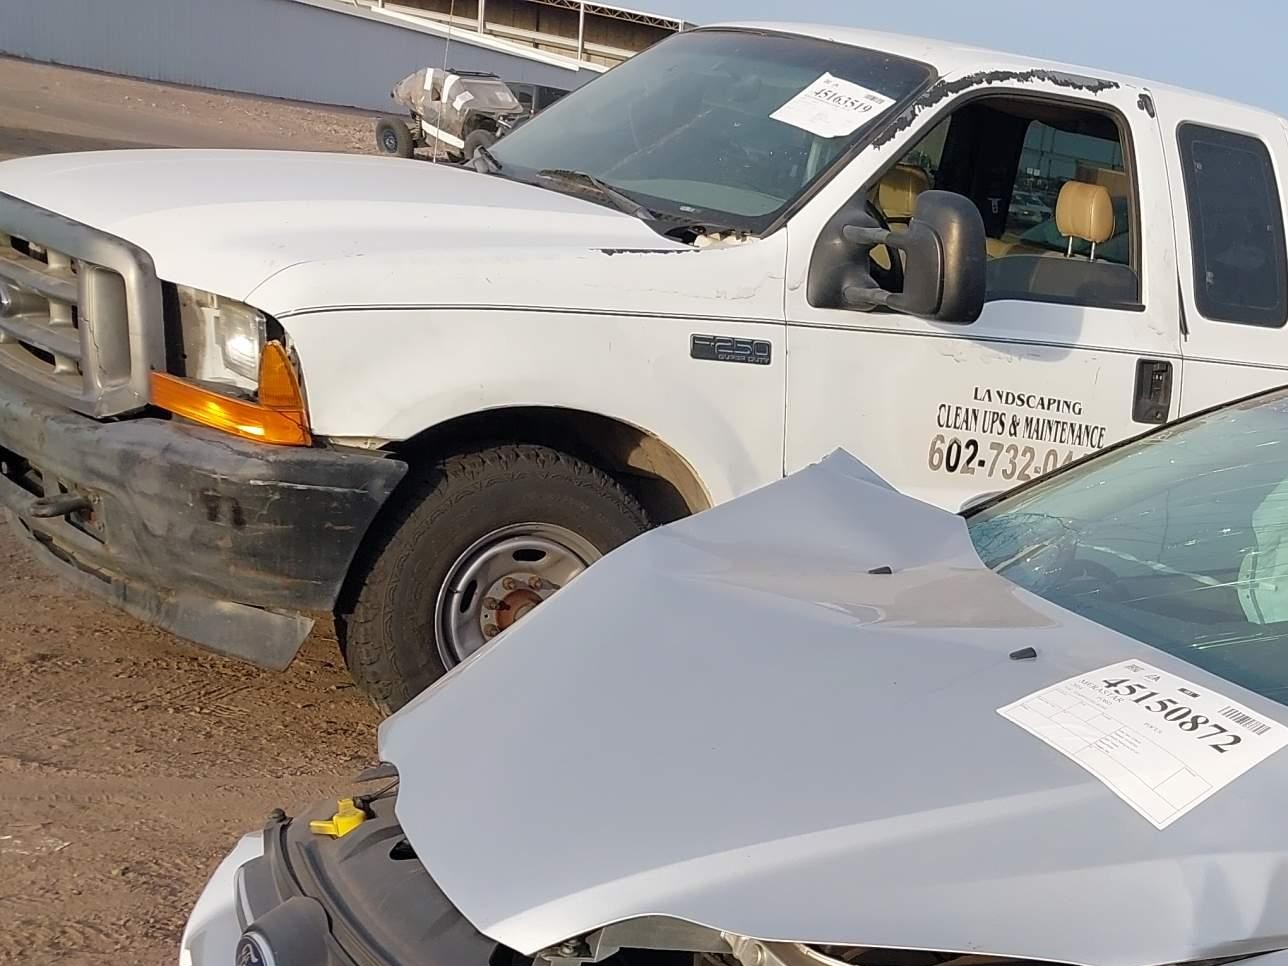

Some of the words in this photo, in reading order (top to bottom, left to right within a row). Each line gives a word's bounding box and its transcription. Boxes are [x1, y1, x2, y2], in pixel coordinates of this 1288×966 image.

[973, 387, 1083, 416] LANDSCAPING
[936, 403, 979, 433] CLEAN
[982, 409, 1006, 436] UPS
[1008, 414, 1020, 438] &
[1022, 415, 1106, 449] MAINTENANCE
[1101, 679, 1242, 754] 45150872
